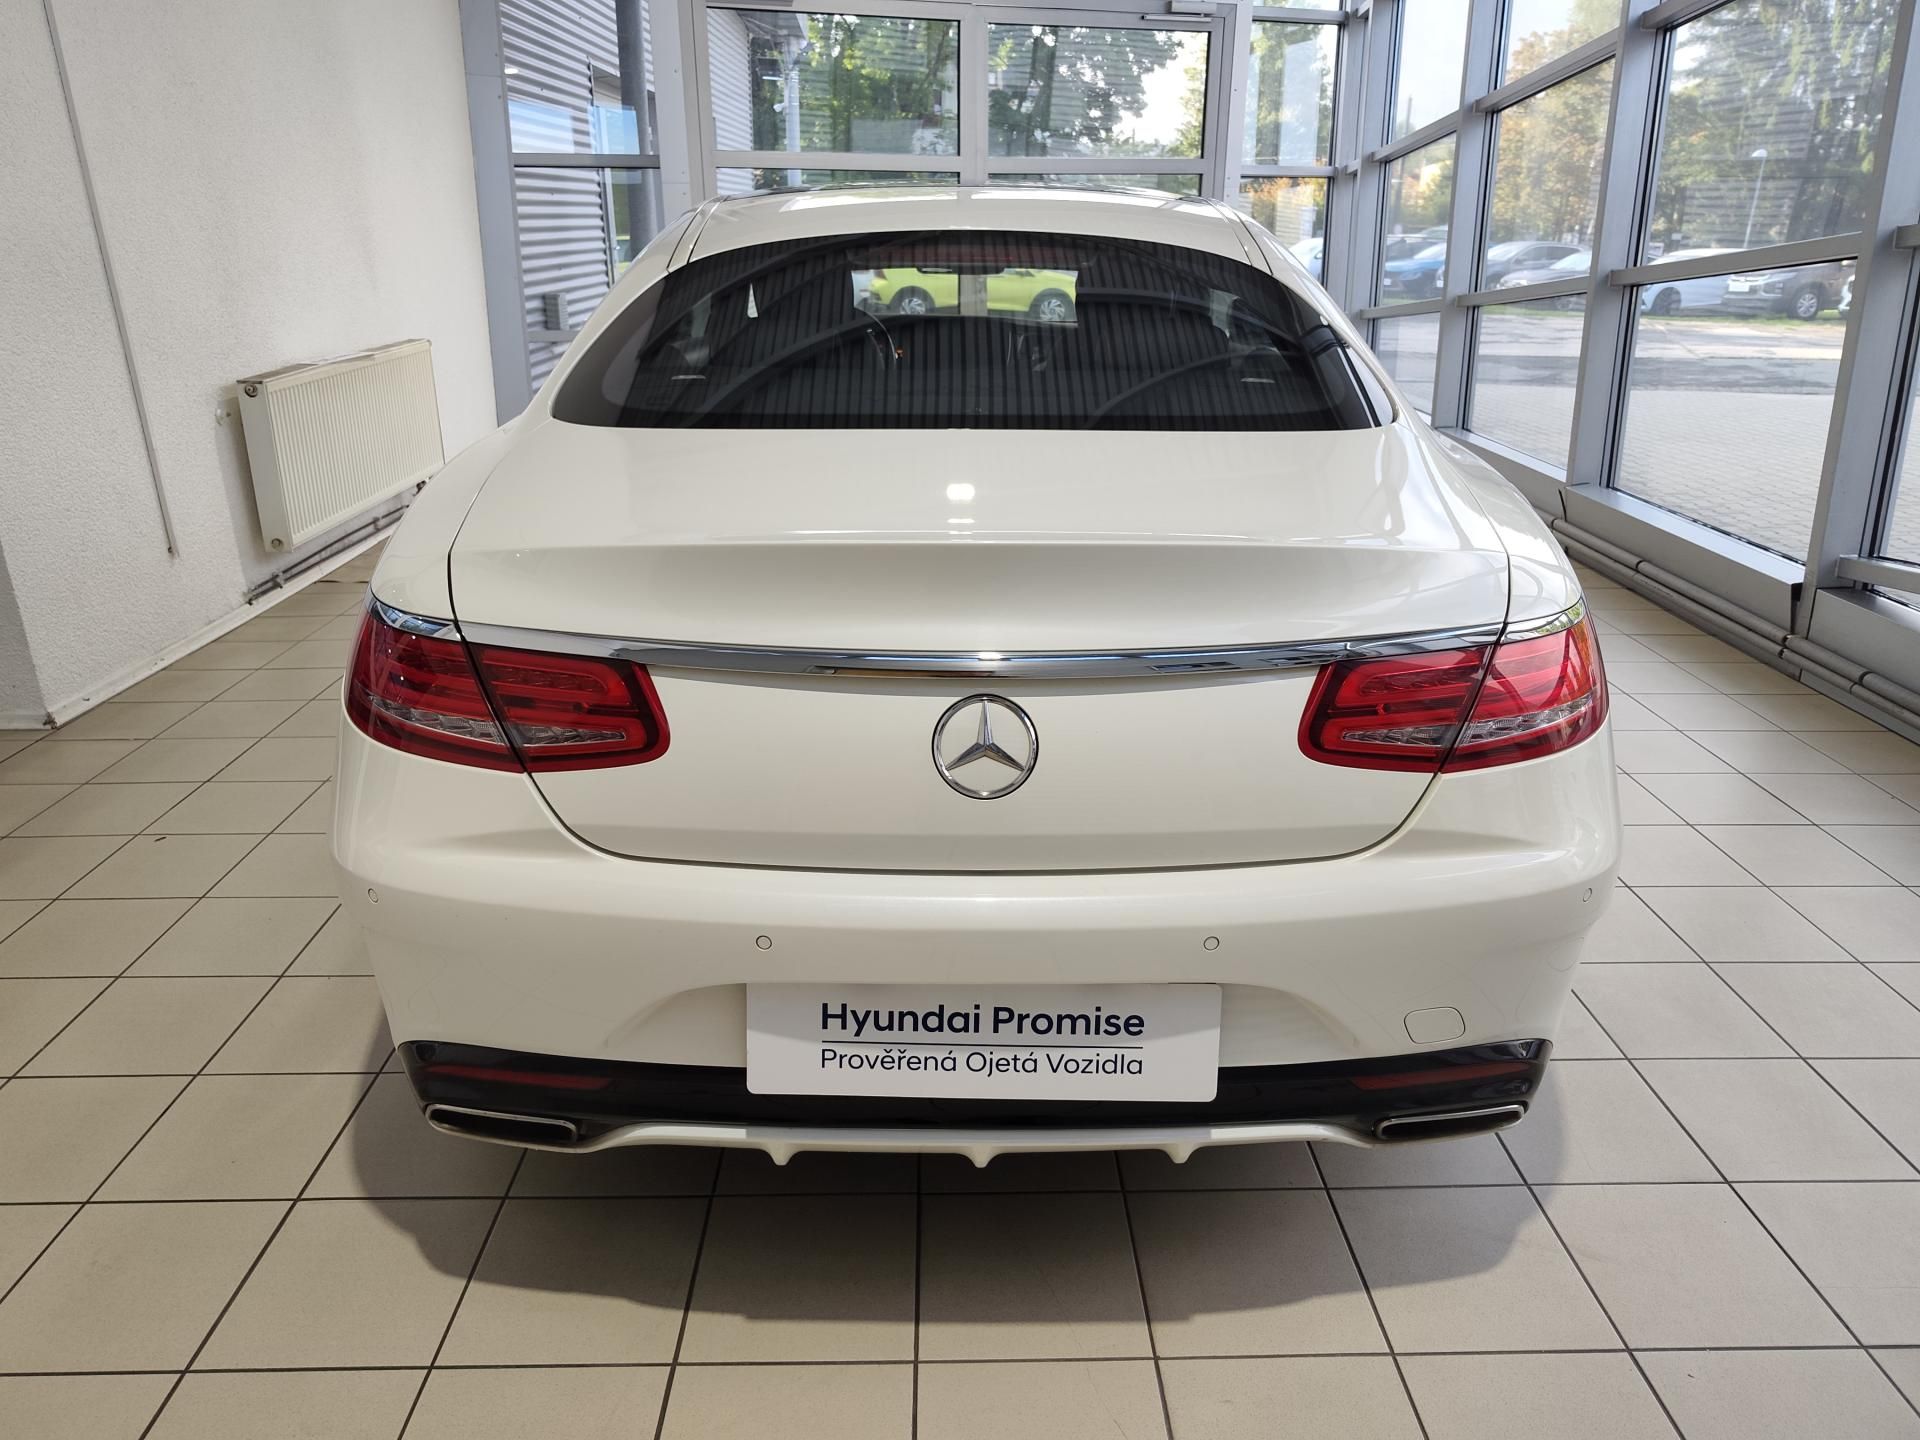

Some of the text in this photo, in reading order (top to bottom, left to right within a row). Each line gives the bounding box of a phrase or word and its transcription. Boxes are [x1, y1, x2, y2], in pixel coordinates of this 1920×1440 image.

[821, 1002, 1145, 1037] Hyundai Promise
[821, 1048, 1143, 1077] Prověřená Ojetá Vozidla
